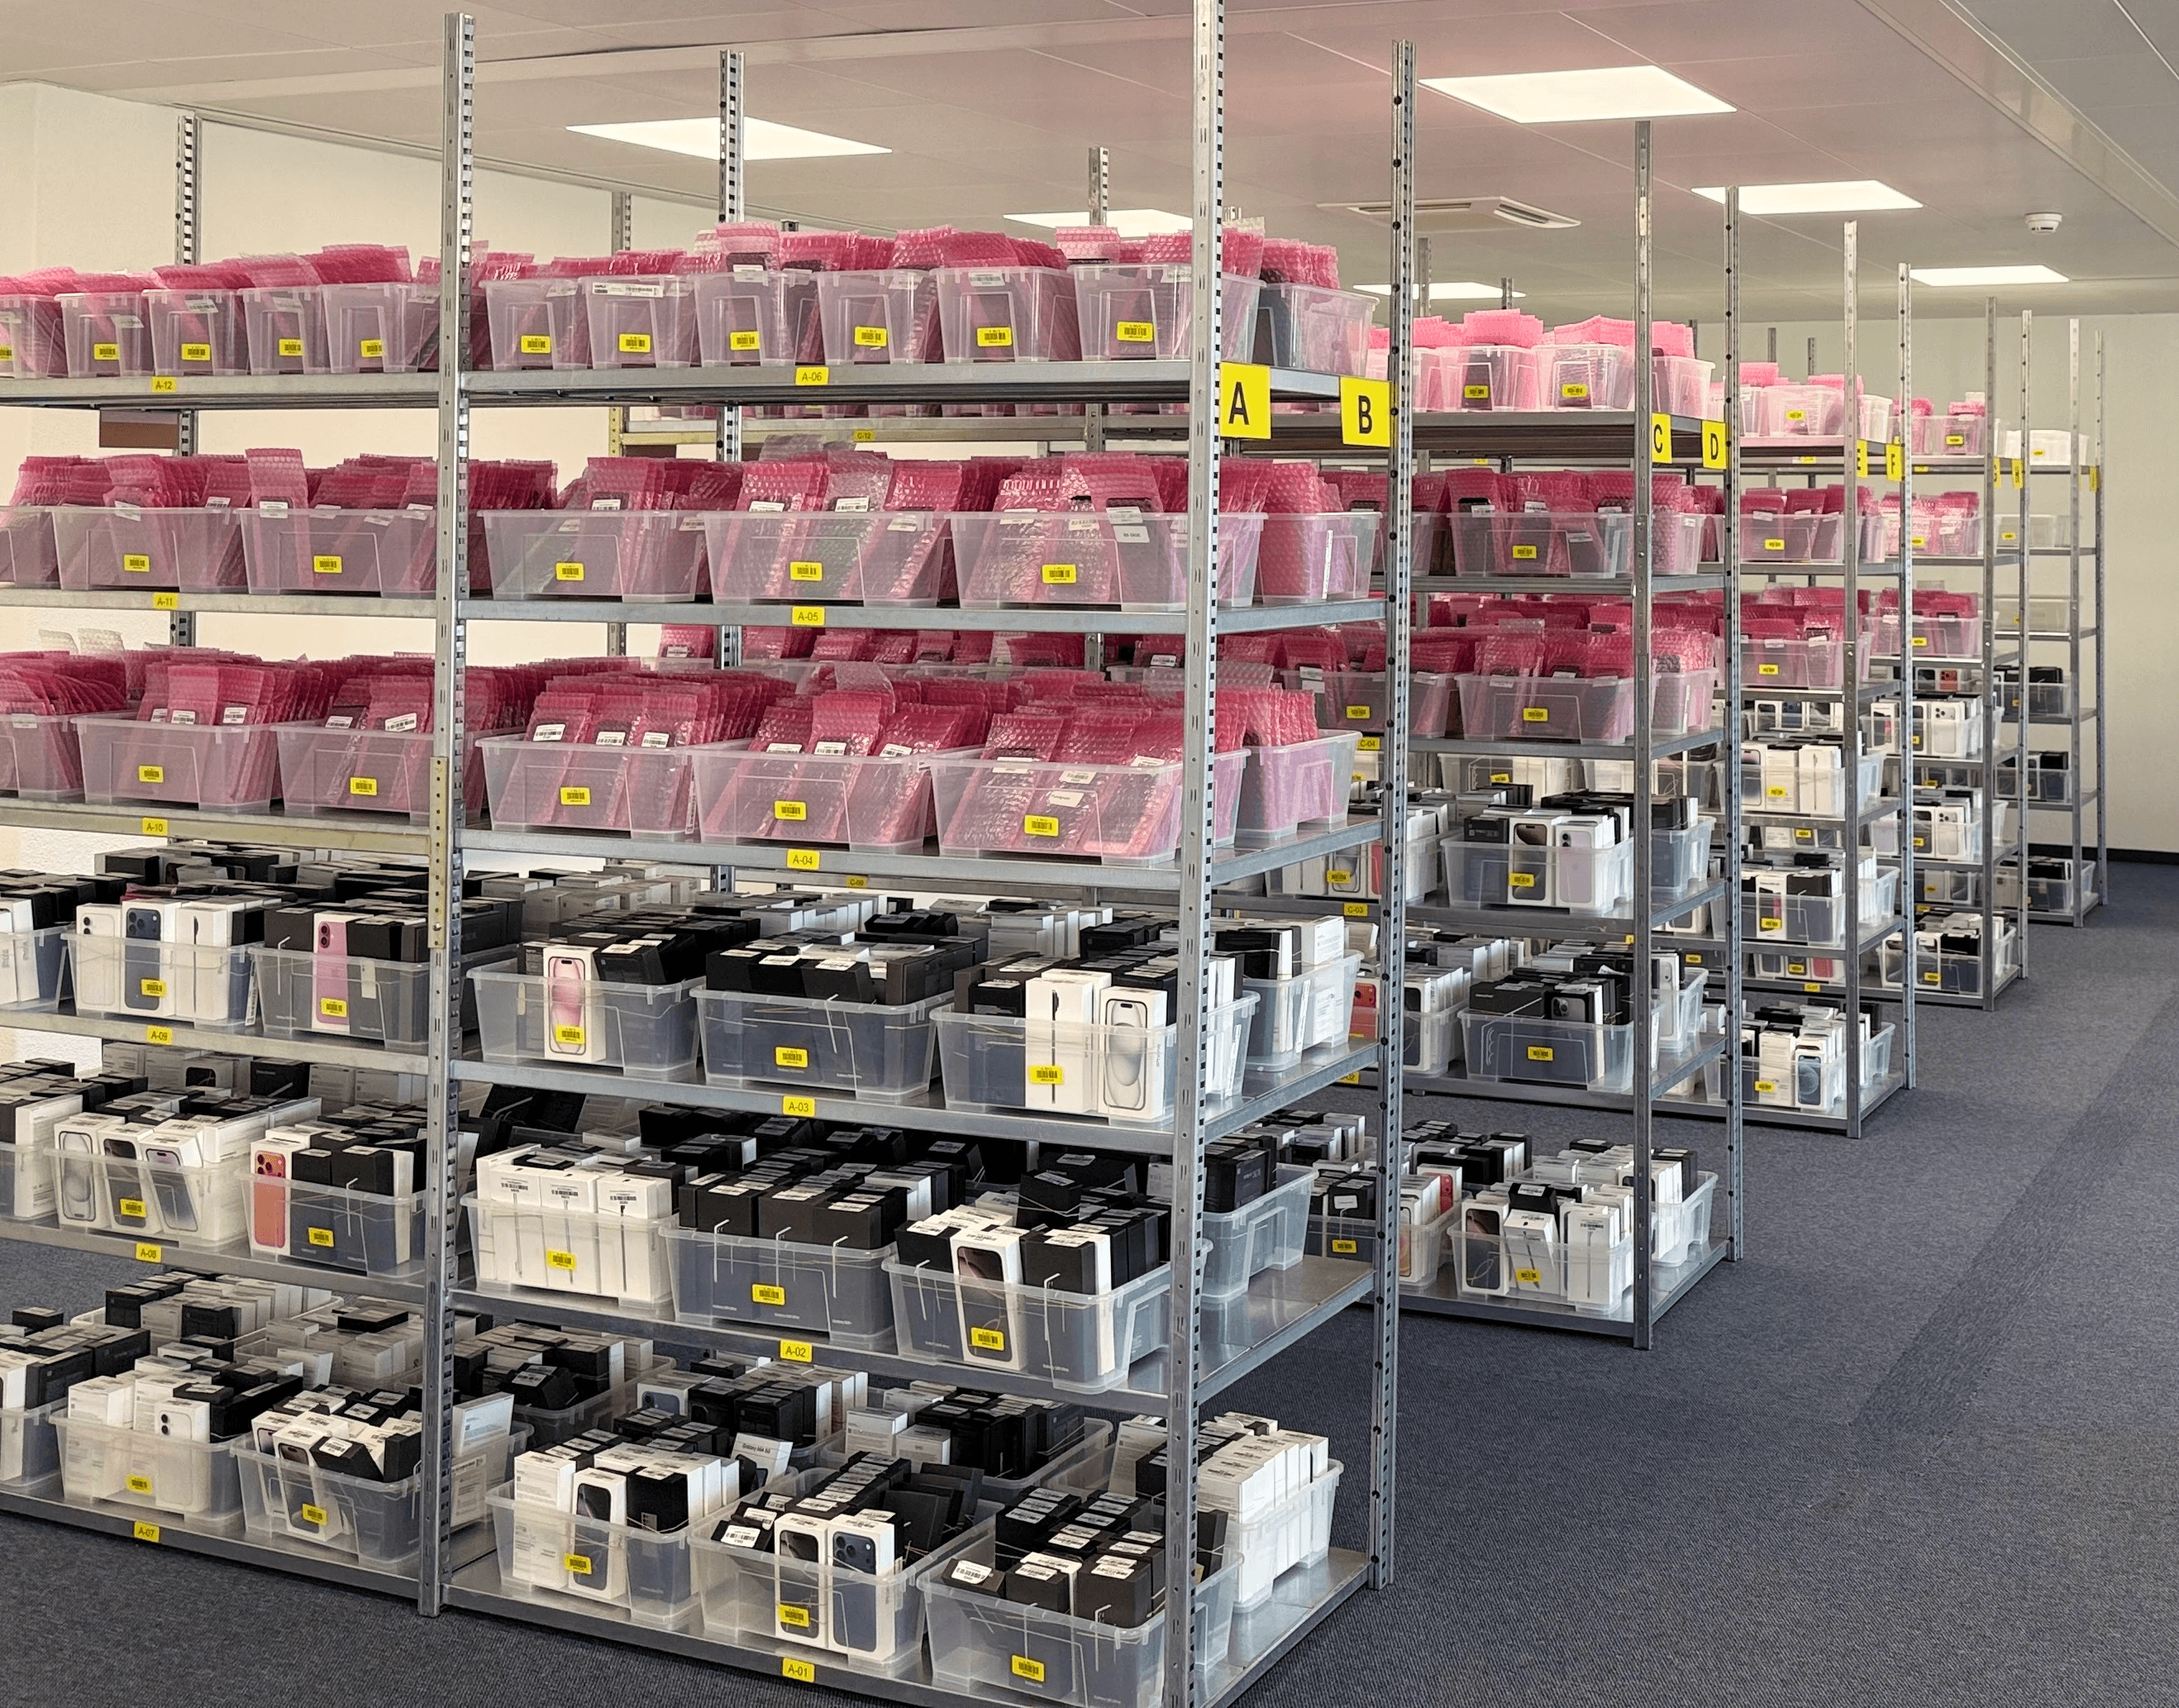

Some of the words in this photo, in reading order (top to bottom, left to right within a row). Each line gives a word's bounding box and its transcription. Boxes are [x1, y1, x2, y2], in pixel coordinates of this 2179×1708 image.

[801, 372, 822, 382] A-06
[155, 381, 173, 390] A-12
[1228, 382, 1250, 426] A
[1358, 395, 1373, 435] B
[1653, 424, 1663, 454] C
[1710, 433, 1719, 460] D
[1891, 454, 1895, 475] F
[156, 598, 173, 606] A-11
[797, 612, 818, 622] A-05
[146, 823, 164, 833] A-10
[792, 855, 813, 866] A-04
[150, 1031, 169, 1042] A-09
[788, 1102, 809, 1114] A-03
[784, 1346, 807, 1358] A-02
[137, 1527, 155, 1539] A-07
[787, 1662, 808, 1678] A-01
